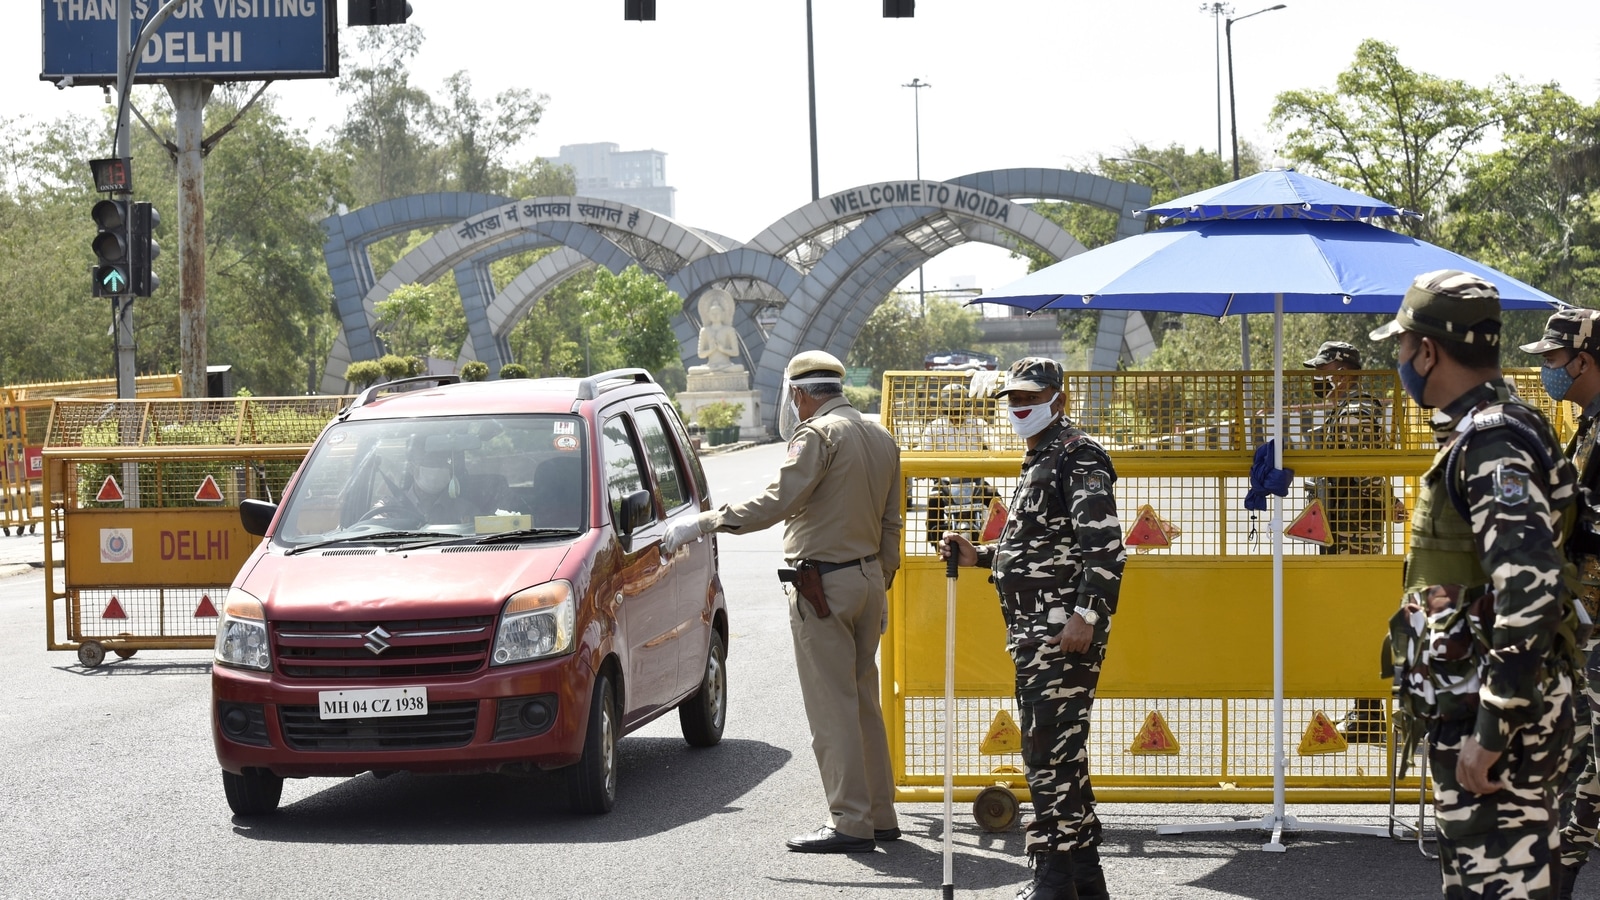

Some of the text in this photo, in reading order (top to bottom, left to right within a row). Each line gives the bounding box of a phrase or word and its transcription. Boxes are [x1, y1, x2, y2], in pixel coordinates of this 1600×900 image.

[53, 0, 148, 21] THANS
[213, 0, 316, 18] VISITING
[141, 31, 242, 63] DELHI
[504, 205, 519, 222] में
[523, 203, 571, 218] आपका
[577, 203, 623, 224] स्वागत
[627, 210, 640, 229] है
[830, 183, 1011, 223] WELCOME TO NOIDA
[160, 529, 229, 561] DELHI
[324, 696, 424, 714] MH 04 CZ 1938
